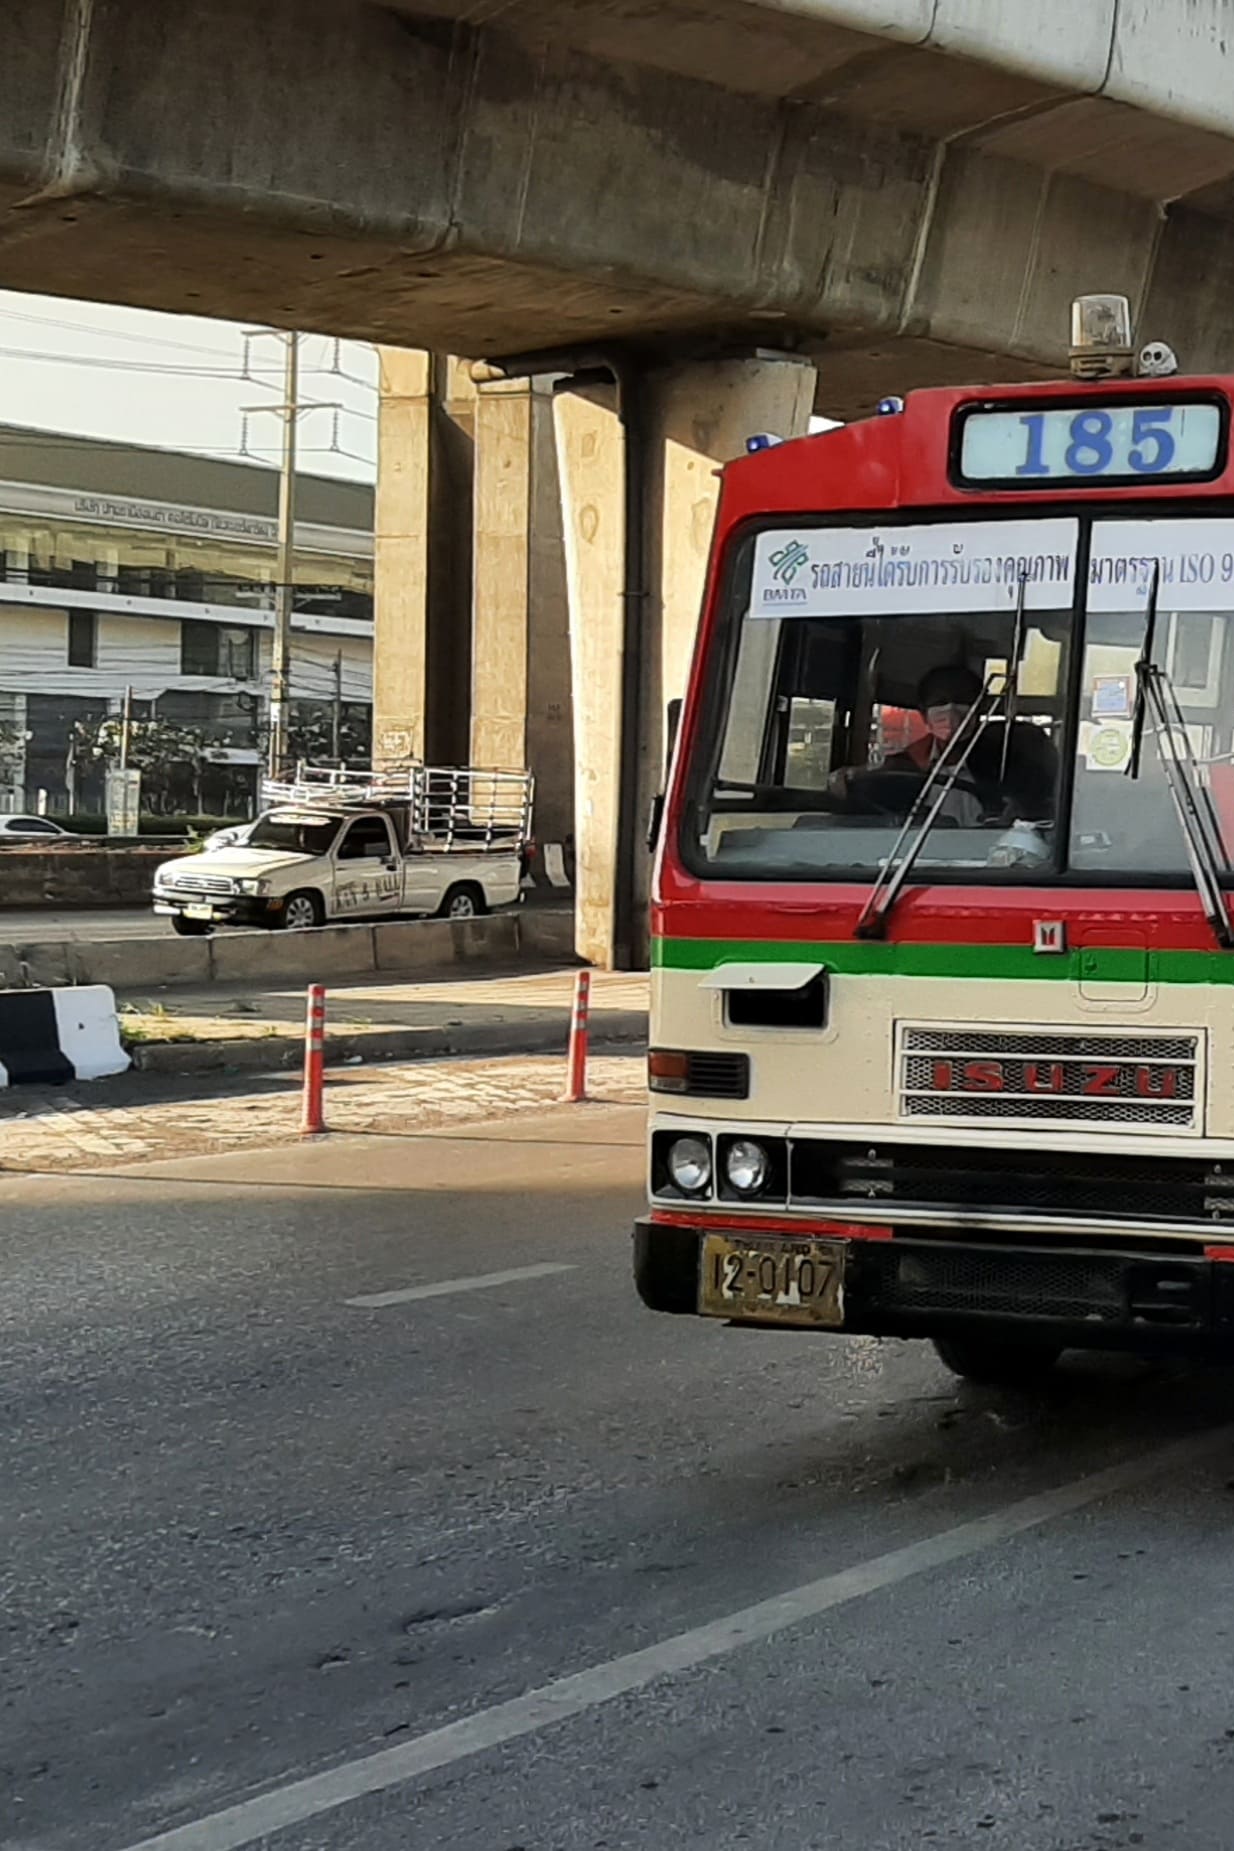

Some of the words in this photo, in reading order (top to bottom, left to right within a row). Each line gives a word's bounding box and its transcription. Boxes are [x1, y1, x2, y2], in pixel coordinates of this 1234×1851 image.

[1015, 407, 1175, 476] 185
[1179, 553, 1216, 584] ISO
[762, 587, 809, 602] BMTA
[933, 1060, 1177, 1097] ISUZU
[713, 1252, 836, 1298] 12-0107
